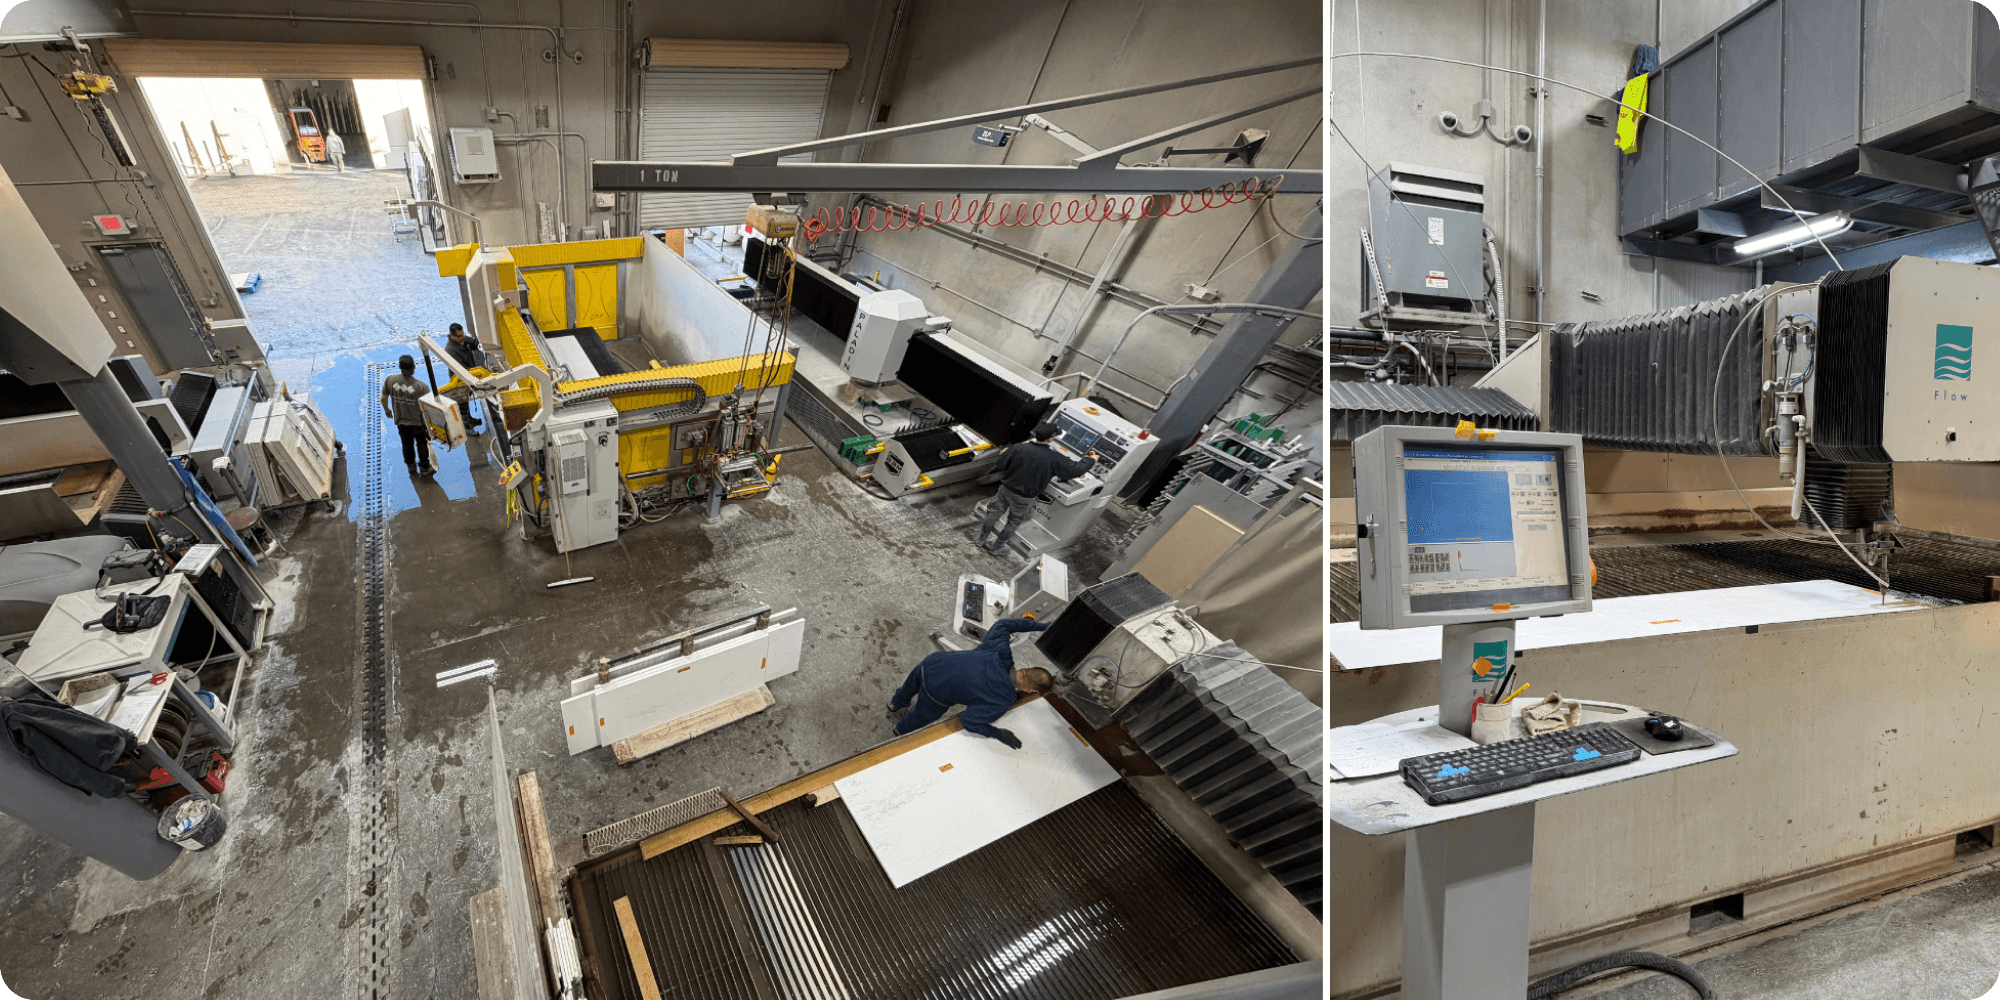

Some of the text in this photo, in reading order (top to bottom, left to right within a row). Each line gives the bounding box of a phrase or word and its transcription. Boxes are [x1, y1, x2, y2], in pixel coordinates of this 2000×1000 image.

[641, 169, 679, 183] 1 TON
[843, 312, 866, 371] PALADIN
[1934, 389, 1968, 401] Flow
